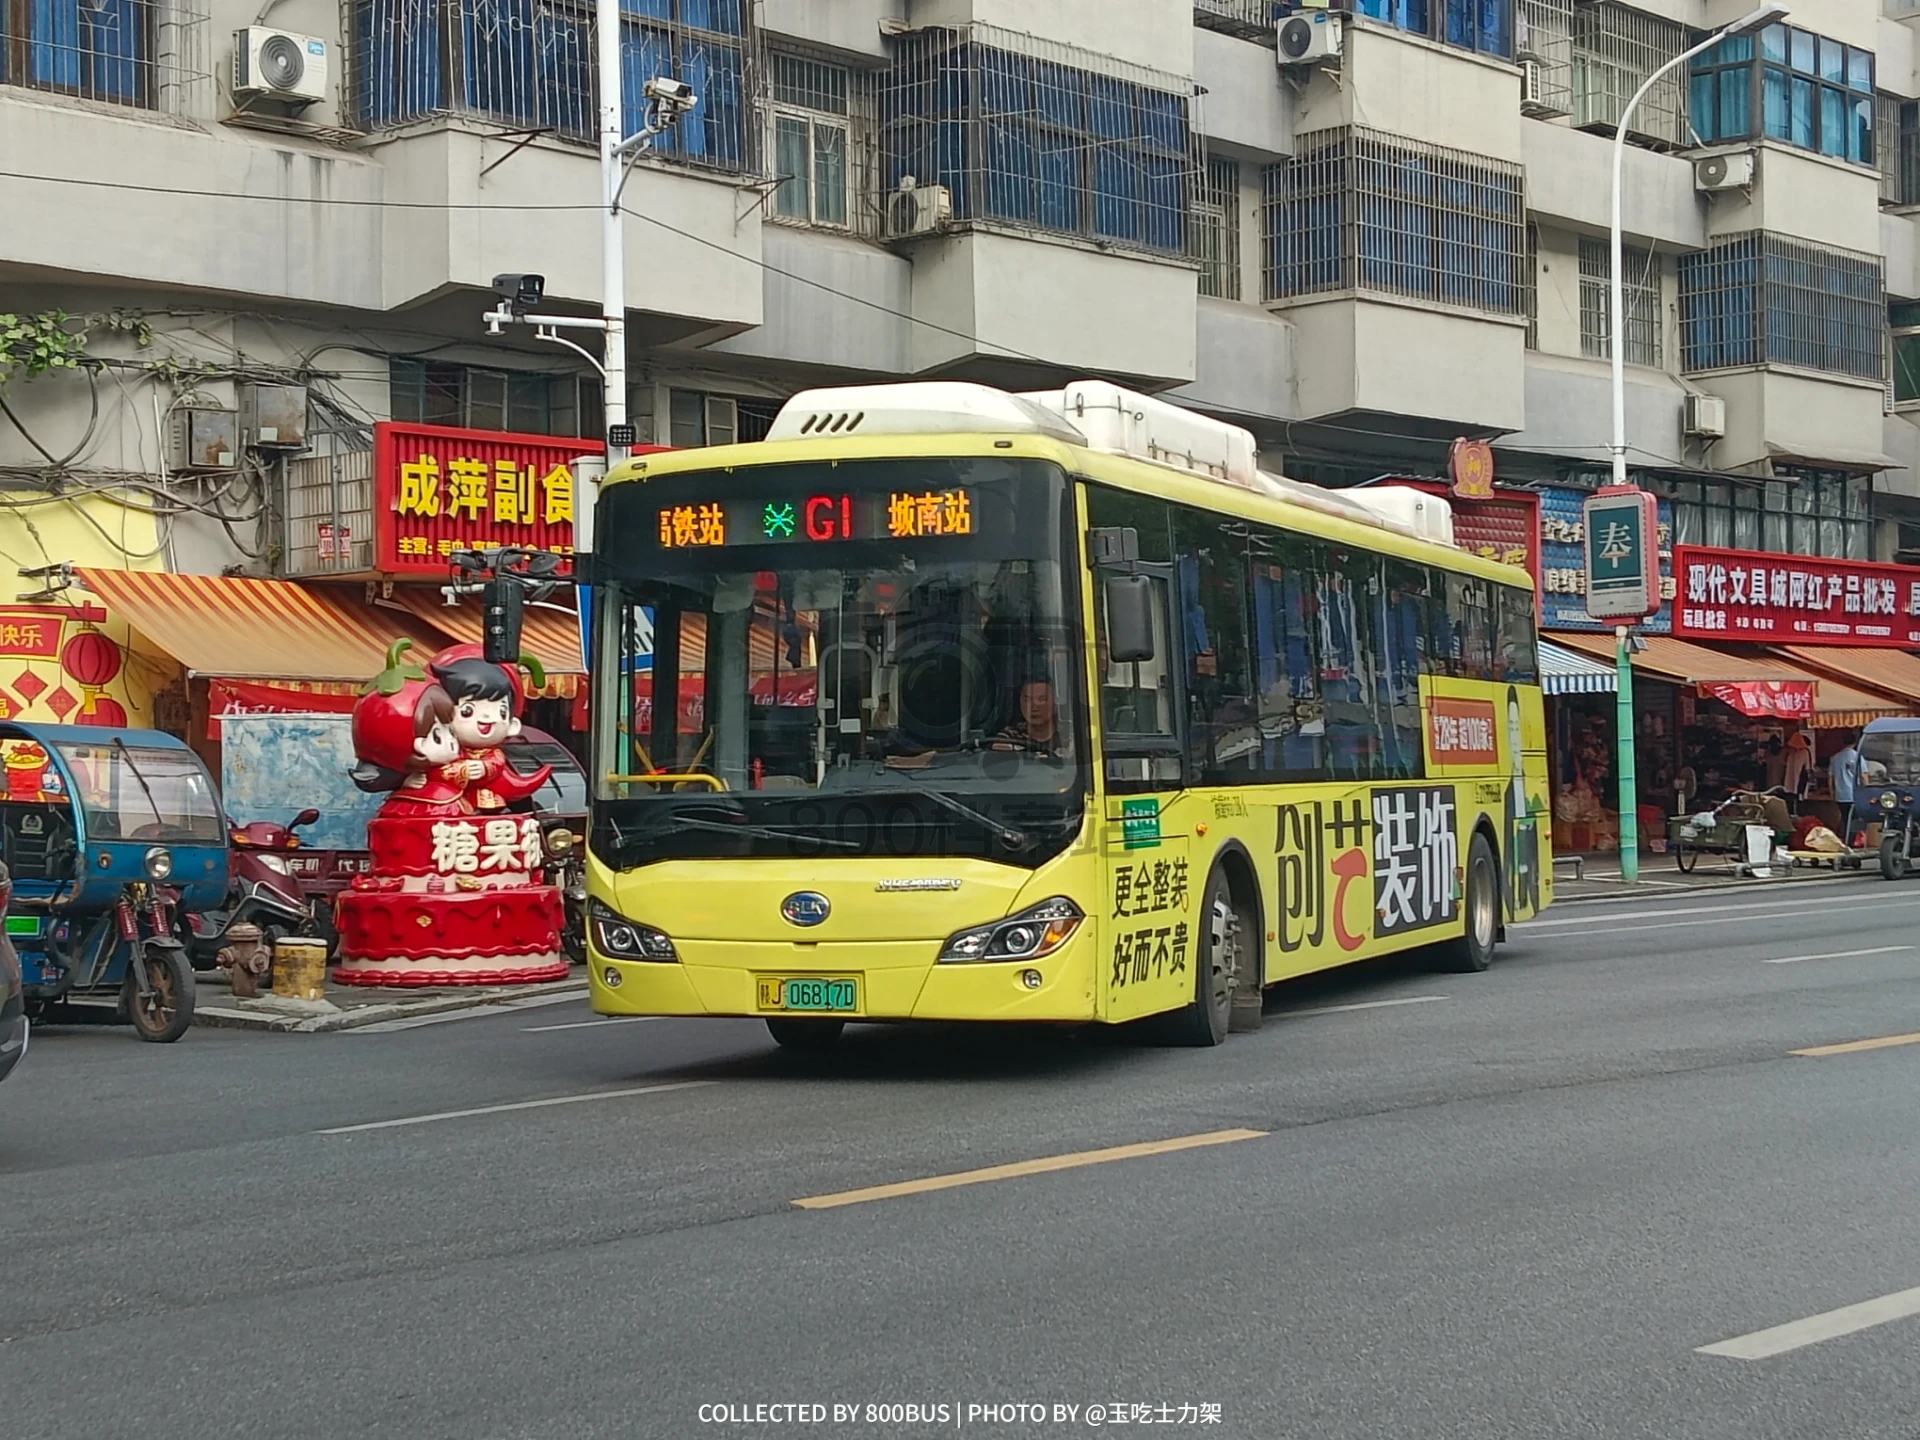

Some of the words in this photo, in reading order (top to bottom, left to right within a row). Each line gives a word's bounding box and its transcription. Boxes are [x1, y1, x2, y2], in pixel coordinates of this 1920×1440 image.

[398, 453, 574, 525] 成萍副食
[888, 490, 970, 536] 城南站
[1688, 564, 1896, 616] 现代文具城网红产品批发
[0, 623, 44, 648] 快乐
[1682, 608, 1727, 630] 玩具批发
[1112, 856, 1189, 920] 更全整装
[1275, 791, 1455, 952] 创艺装饰
[1111, 921, 1189, 987] 好而不贵
[790, 983, 854, 1006] 06817D
